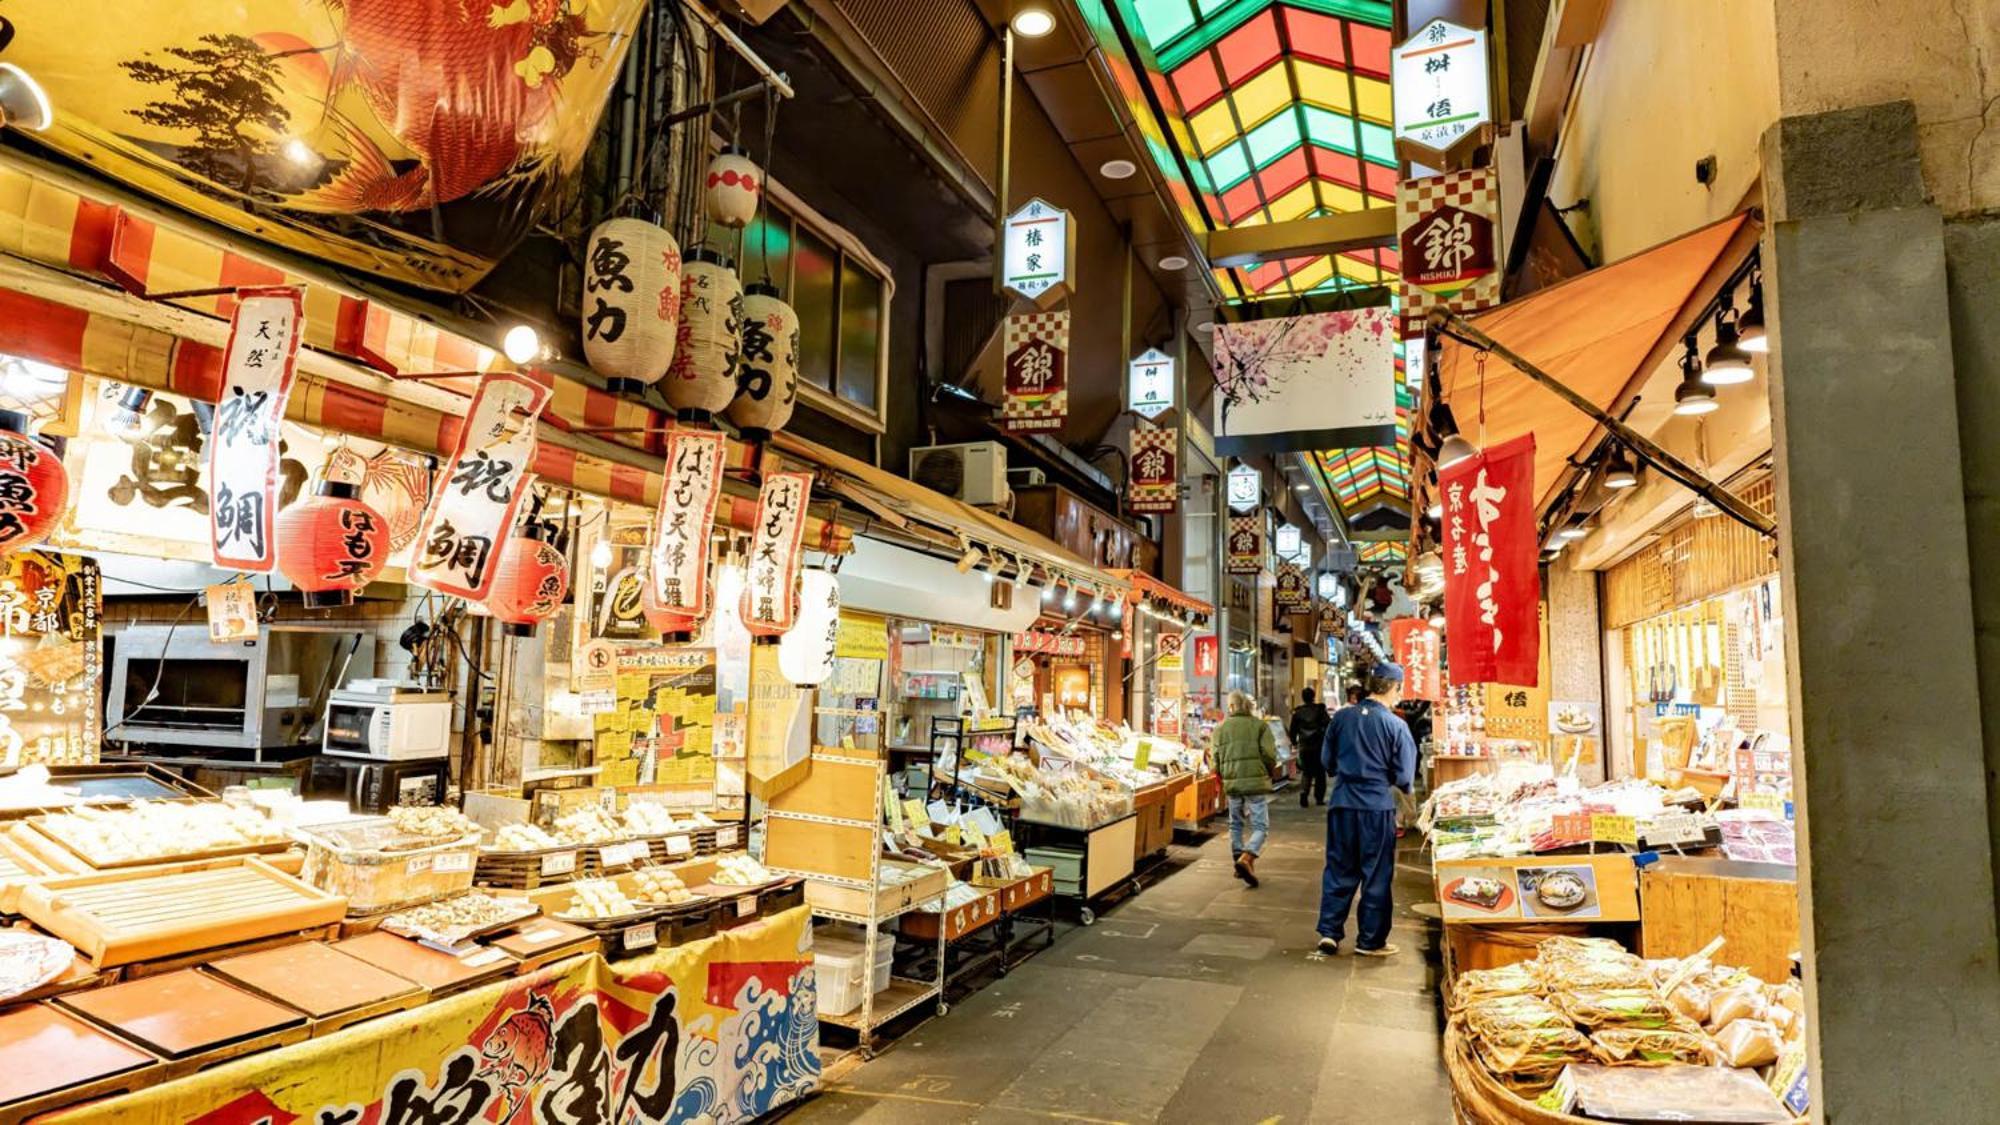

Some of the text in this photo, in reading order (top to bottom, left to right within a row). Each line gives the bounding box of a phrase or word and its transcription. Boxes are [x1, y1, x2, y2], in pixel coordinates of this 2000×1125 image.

[1025, 228, 1044, 272] 椿家
[1413, 211, 1475, 279] 錦
[1420, 269, 1456, 281] NISHIKI
[587, 237, 634, 343] 魚力
[244, 319, 271, 368] 天然
[740, 316, 775, 402] 魚力
[1014, 345, 1054, 393] 錦
[215, 384, 270, 558] 祝鯛
[1136, 449, 1166, 483] 錦
[327, 509, 376, 581] はも天
[419, 450, 513, 589] 祝鯛
[662, 445, 705, 608] はも天婦羅
[756, 483, 791, 622] はも天婦羅
[34, 588, 60, 634] 京都
